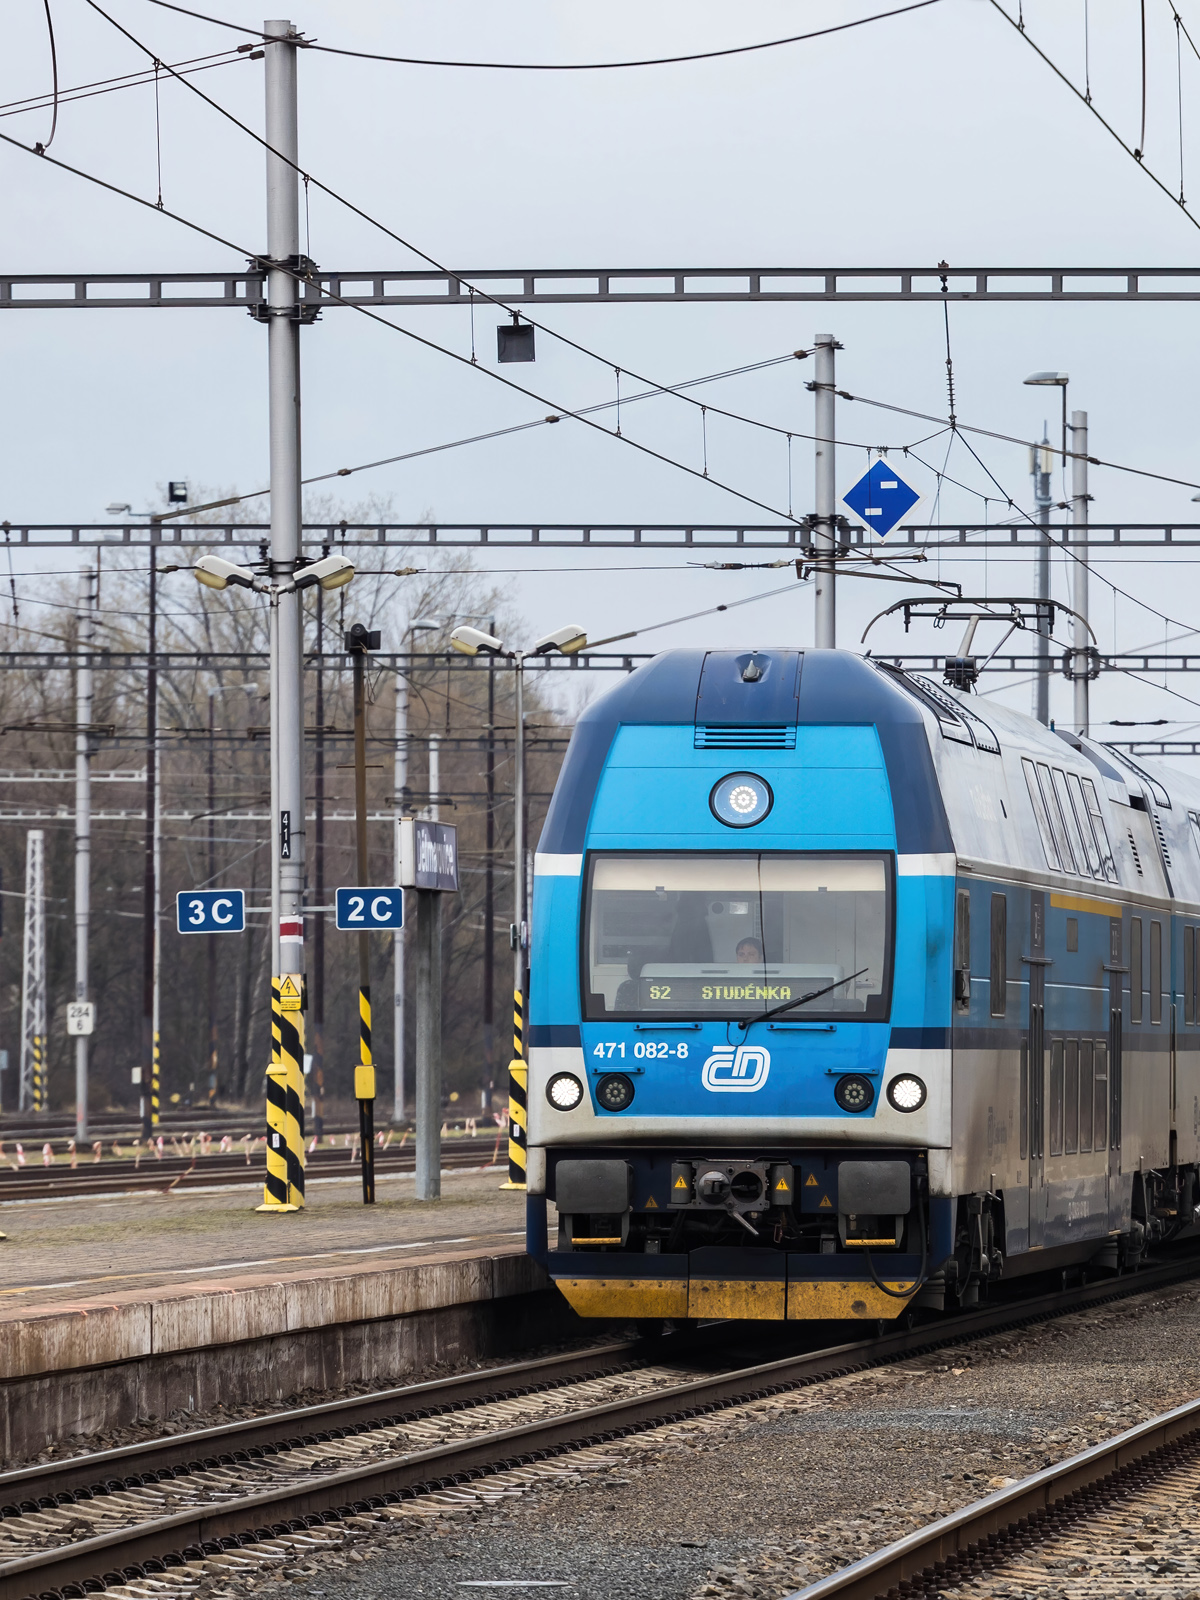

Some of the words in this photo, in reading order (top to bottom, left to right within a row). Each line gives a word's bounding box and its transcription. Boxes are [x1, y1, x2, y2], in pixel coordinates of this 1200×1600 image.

[650, 985, 671, 1000] S2
[593, 1042, 626, 1059] 471
[633, 1042, 689, 1059] 082-8
